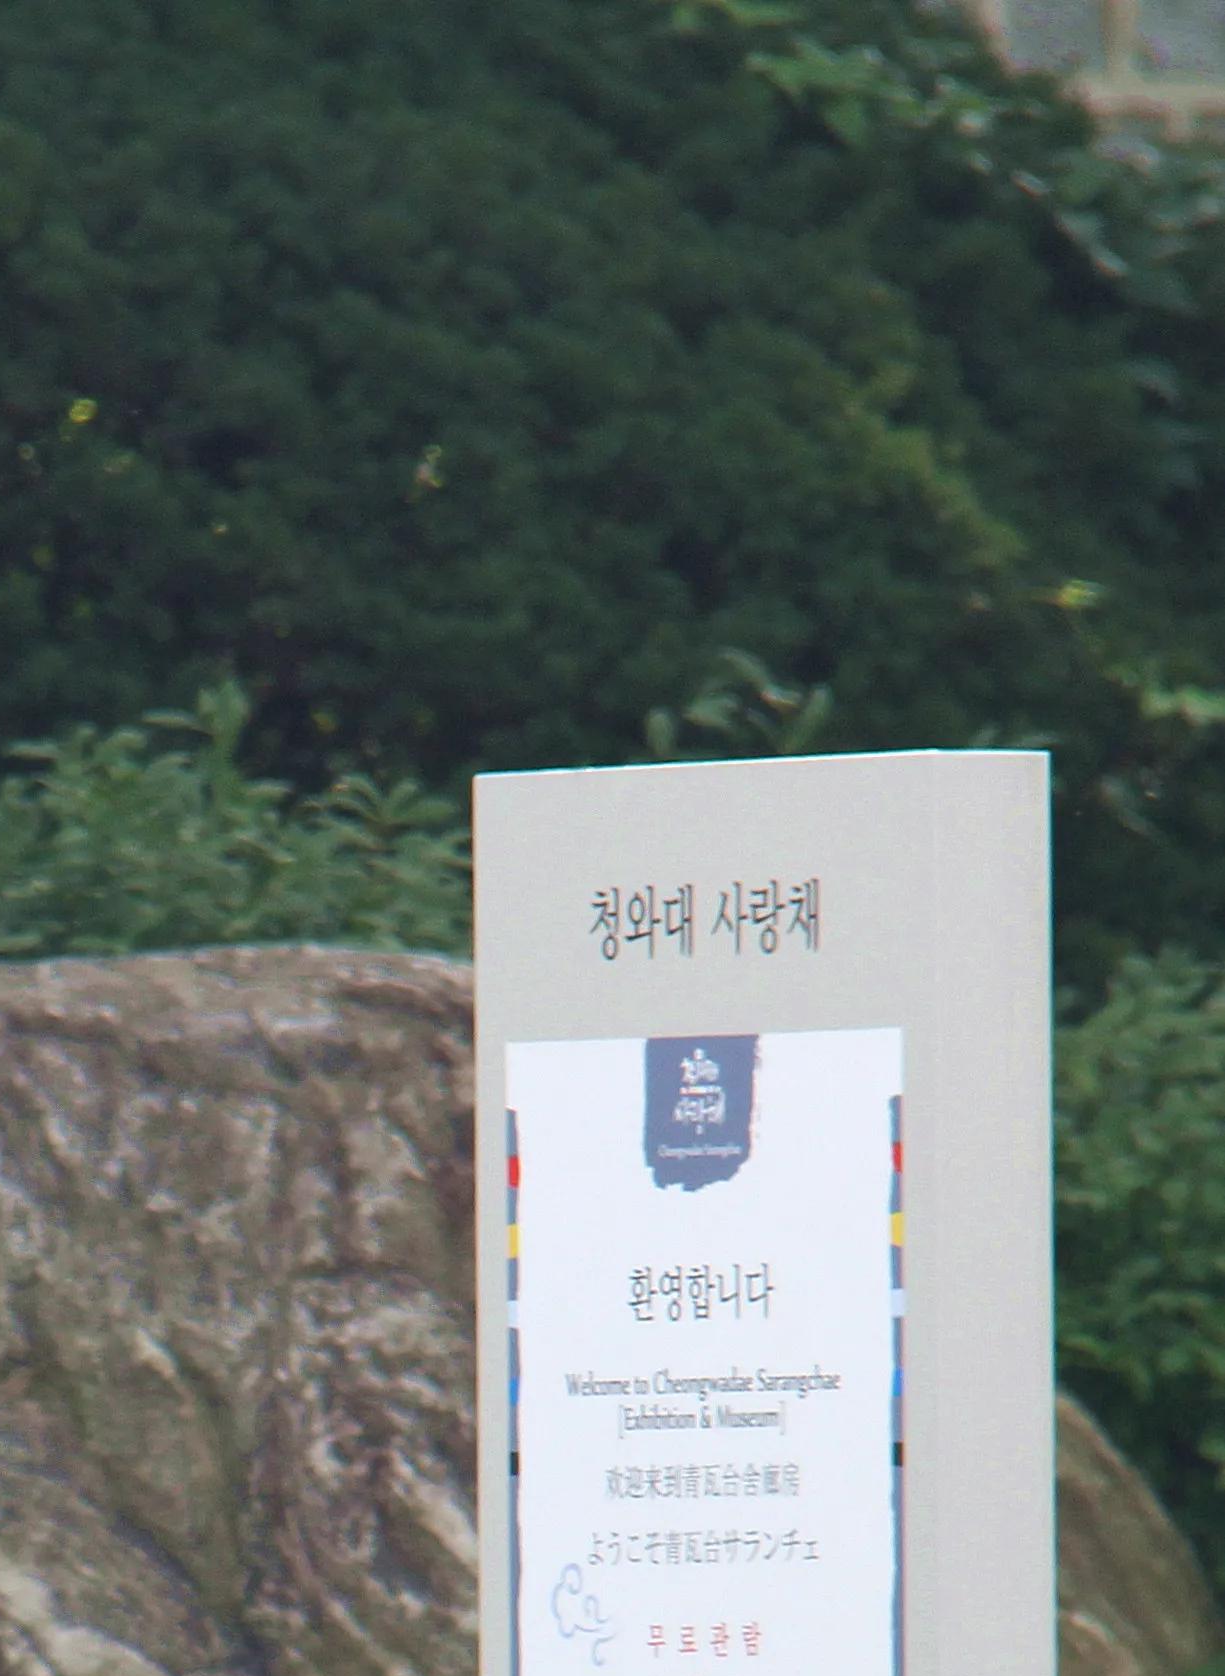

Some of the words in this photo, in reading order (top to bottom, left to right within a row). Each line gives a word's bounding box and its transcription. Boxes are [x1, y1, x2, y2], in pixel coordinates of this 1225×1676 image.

[590, 884, 695, 961] 청와대
[712, 877, 820, 957] 사랑채
[628, 1262, 774, 1322] 환영합니다
[566, 1371, 630, 1397] Welcome
[633, 1376, 649, 1396] to
[653, 1367, 753, 1401] Cheongwadae
[757, 1364, 841, 1398] Sarangchae
[699, 1406, 712, 1429] &
